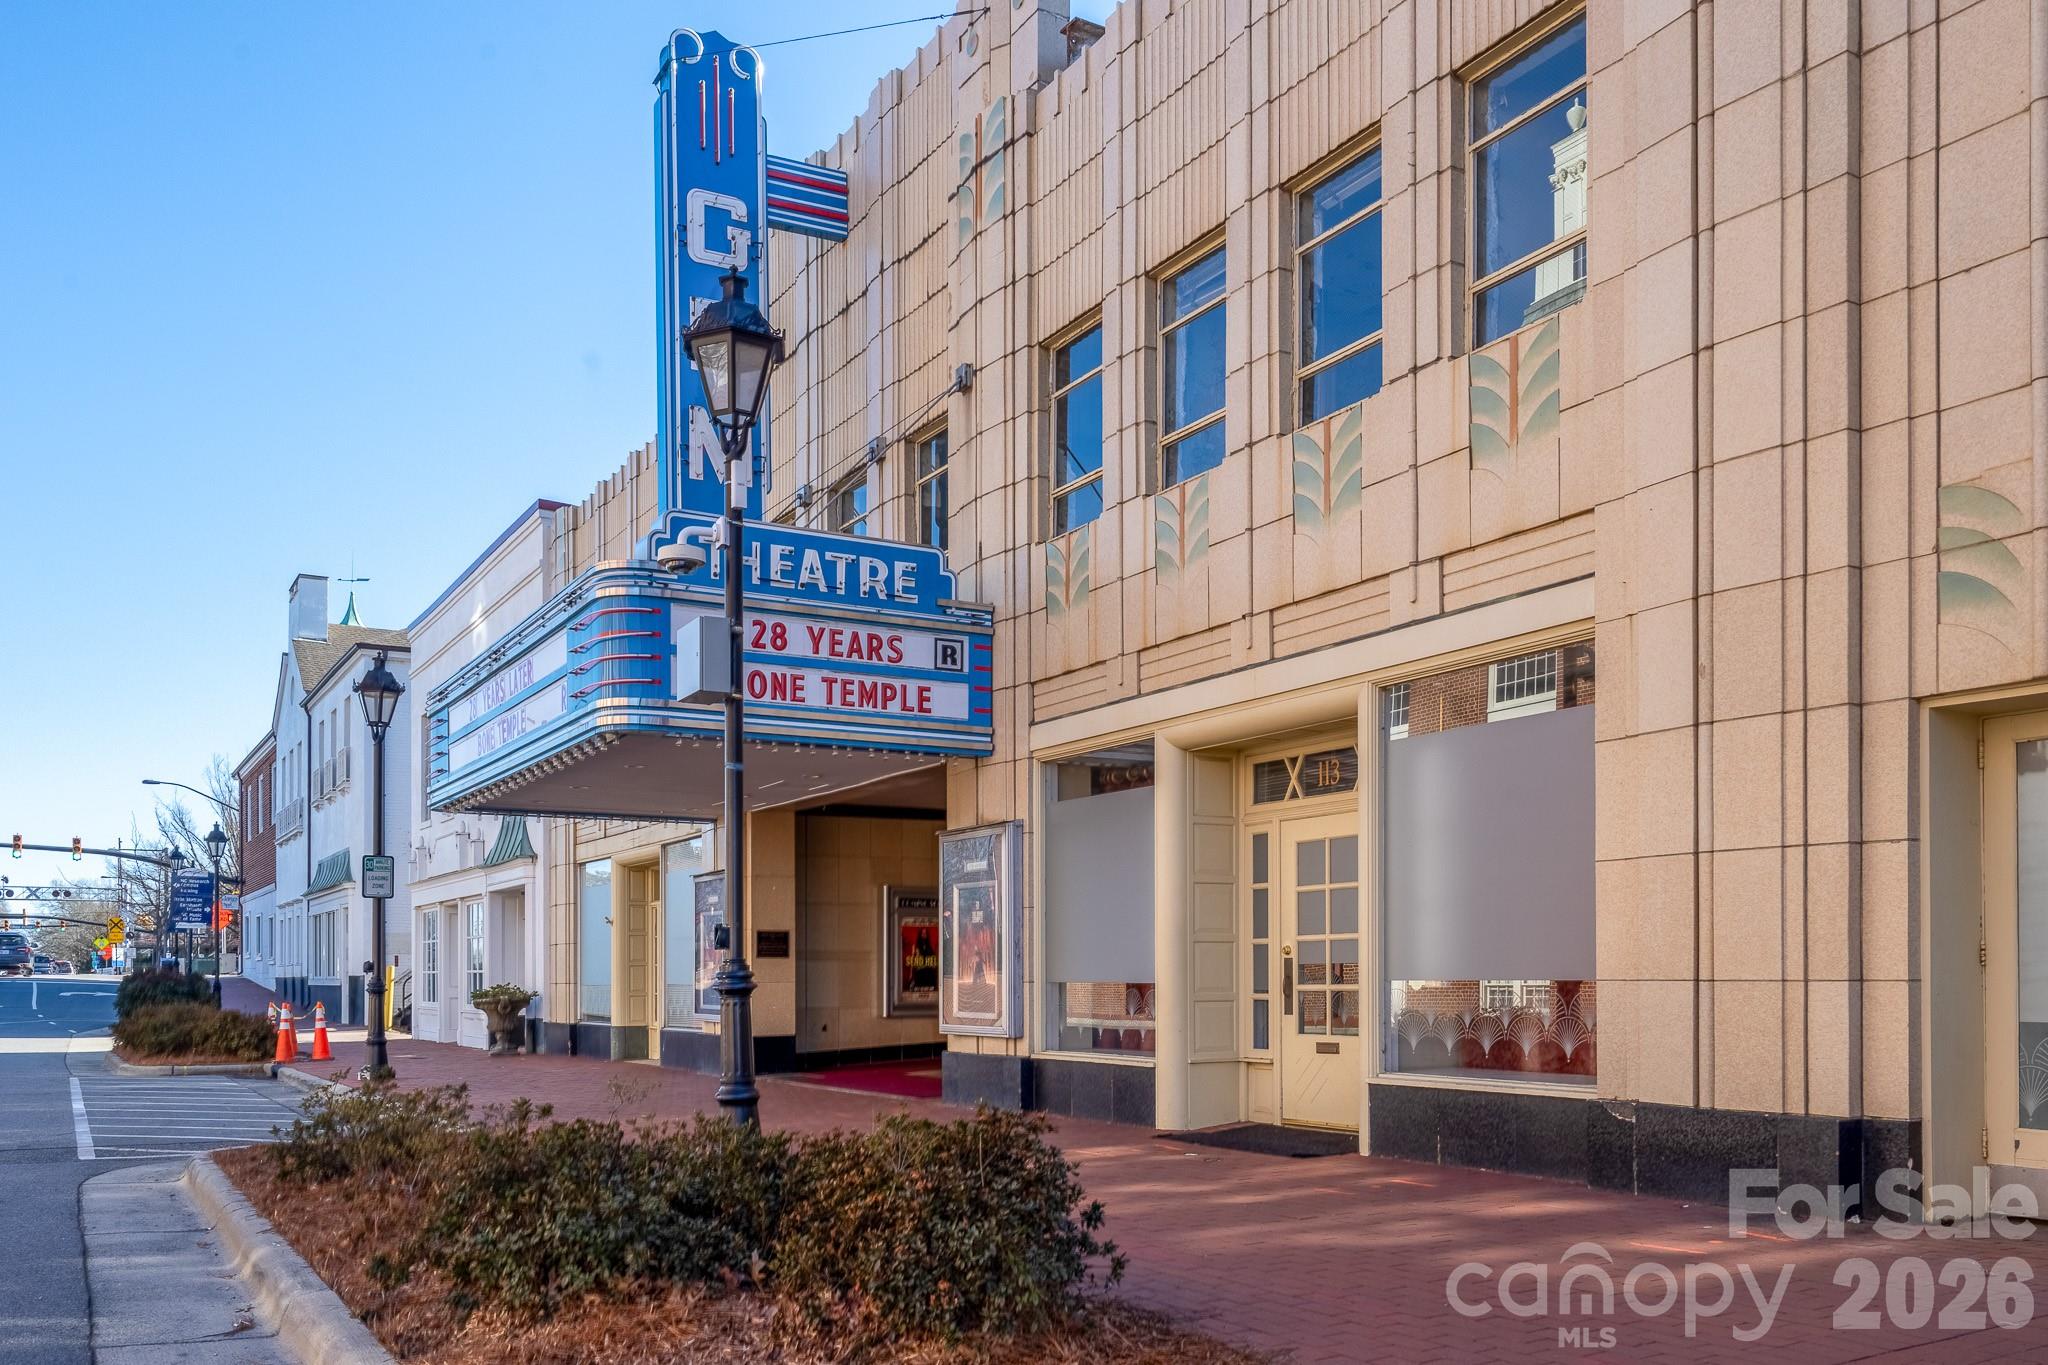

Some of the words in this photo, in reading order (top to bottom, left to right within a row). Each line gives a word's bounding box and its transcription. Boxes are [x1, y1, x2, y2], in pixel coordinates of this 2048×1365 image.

[699, 536, 918, 604] THEATRE
[751, 620, 788, 651] 28
[806, 626, 904, 664] YEARS
[941, 644, 958, 666] R
[469, 697, 478, 722] 28
[483, 680, 506, 712] YEARS
[509, 656, 535, 696] LATER
[561, 684, 567, 713] R
[747, 670, 806, 703] ONE
[821, 677, 932, 714] TEMPLE
[497, 709, 527, 746] TEMPLE
[1318, 759, 1341, 787] 113
[366, 860, 374, 869] 30
